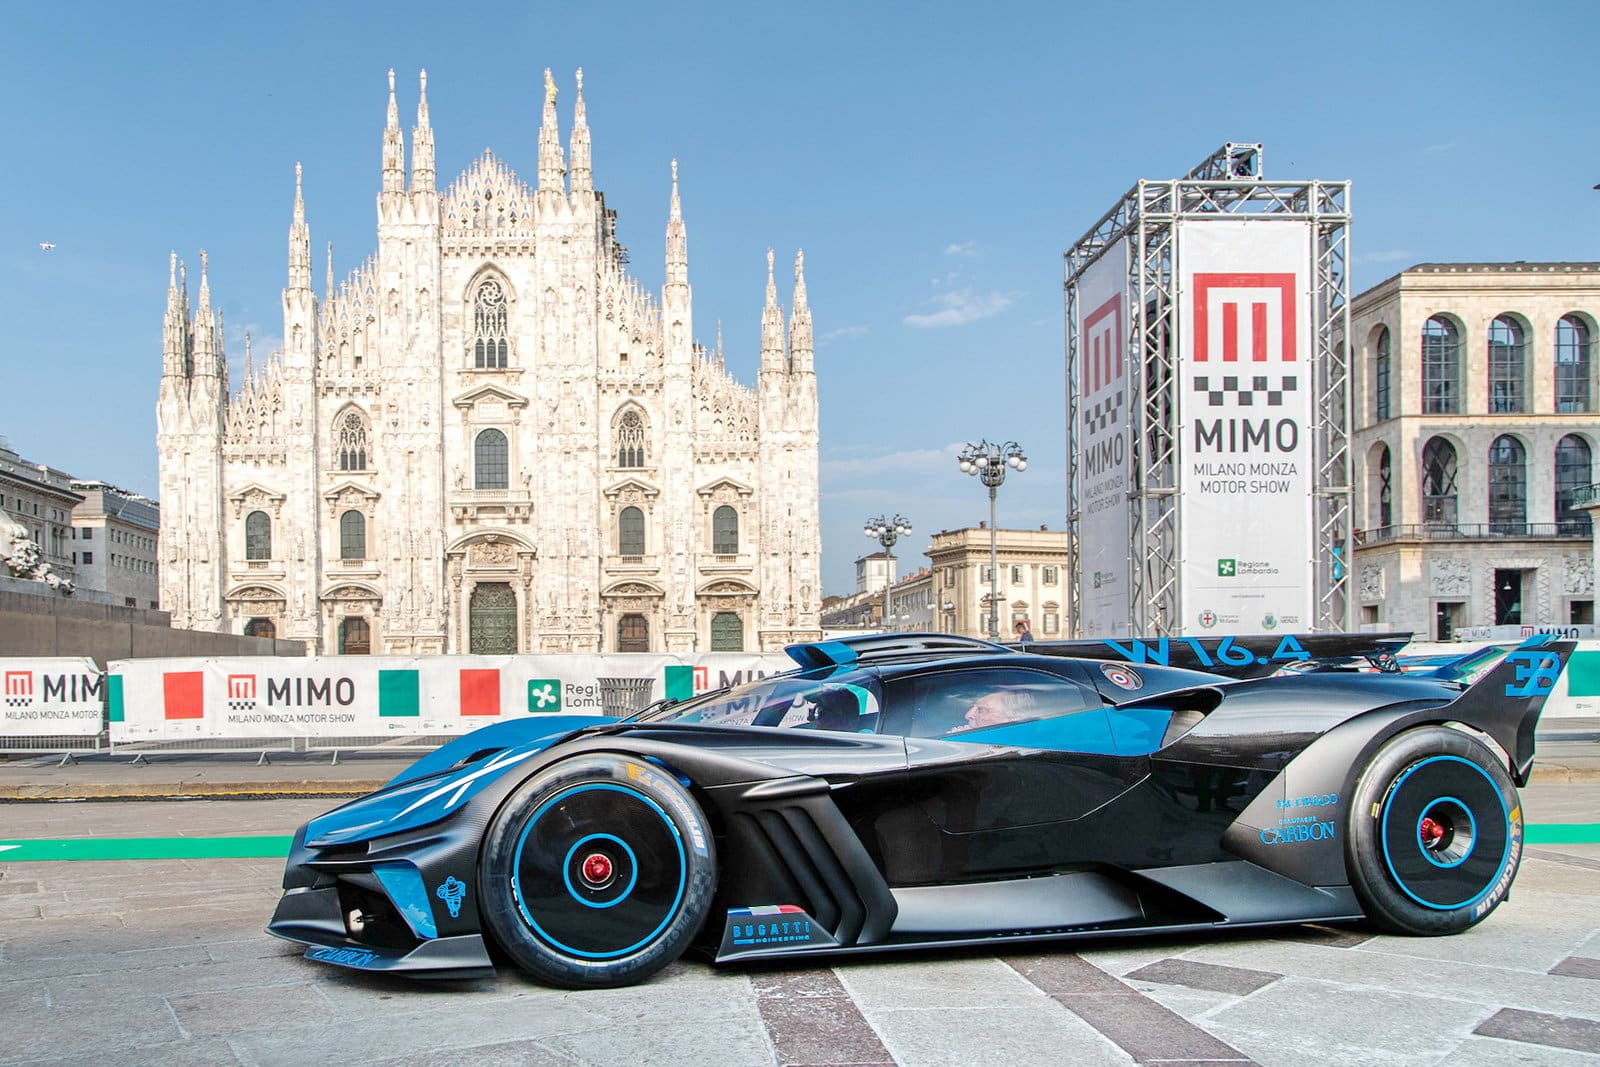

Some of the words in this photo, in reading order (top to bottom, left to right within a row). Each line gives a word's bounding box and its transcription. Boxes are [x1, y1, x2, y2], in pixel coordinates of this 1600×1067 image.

[1195, 418, 1298, 453] MIMO
[1085, 432, 1123, 480] MIMO
[1193, 462, 1246, 476] MILANO
[1250, 462, 1298, 476] MONZA
[1200, 480, 1247, 494] MOTOR
[1250, 480, 1290, 494] SHOW
[267, 677, 355, 706] MIMO
[5, 711, 38, 720] MILANO
[40, 711, 70, 720] MONZA
[72, 710, 99, 719] MOTOR
[228, 714, 262, 723] MILANO
[264, 714, 294, 723] MONZA
[296, 714, 327, 723] MOTOR
[329, 713, 356, 723] SHOW
[1260, 821, 1336, 845] CARBON
[1476, 841, 1520, 917] MICHELIN
[733, 921, 810, 938] BUGATTI
